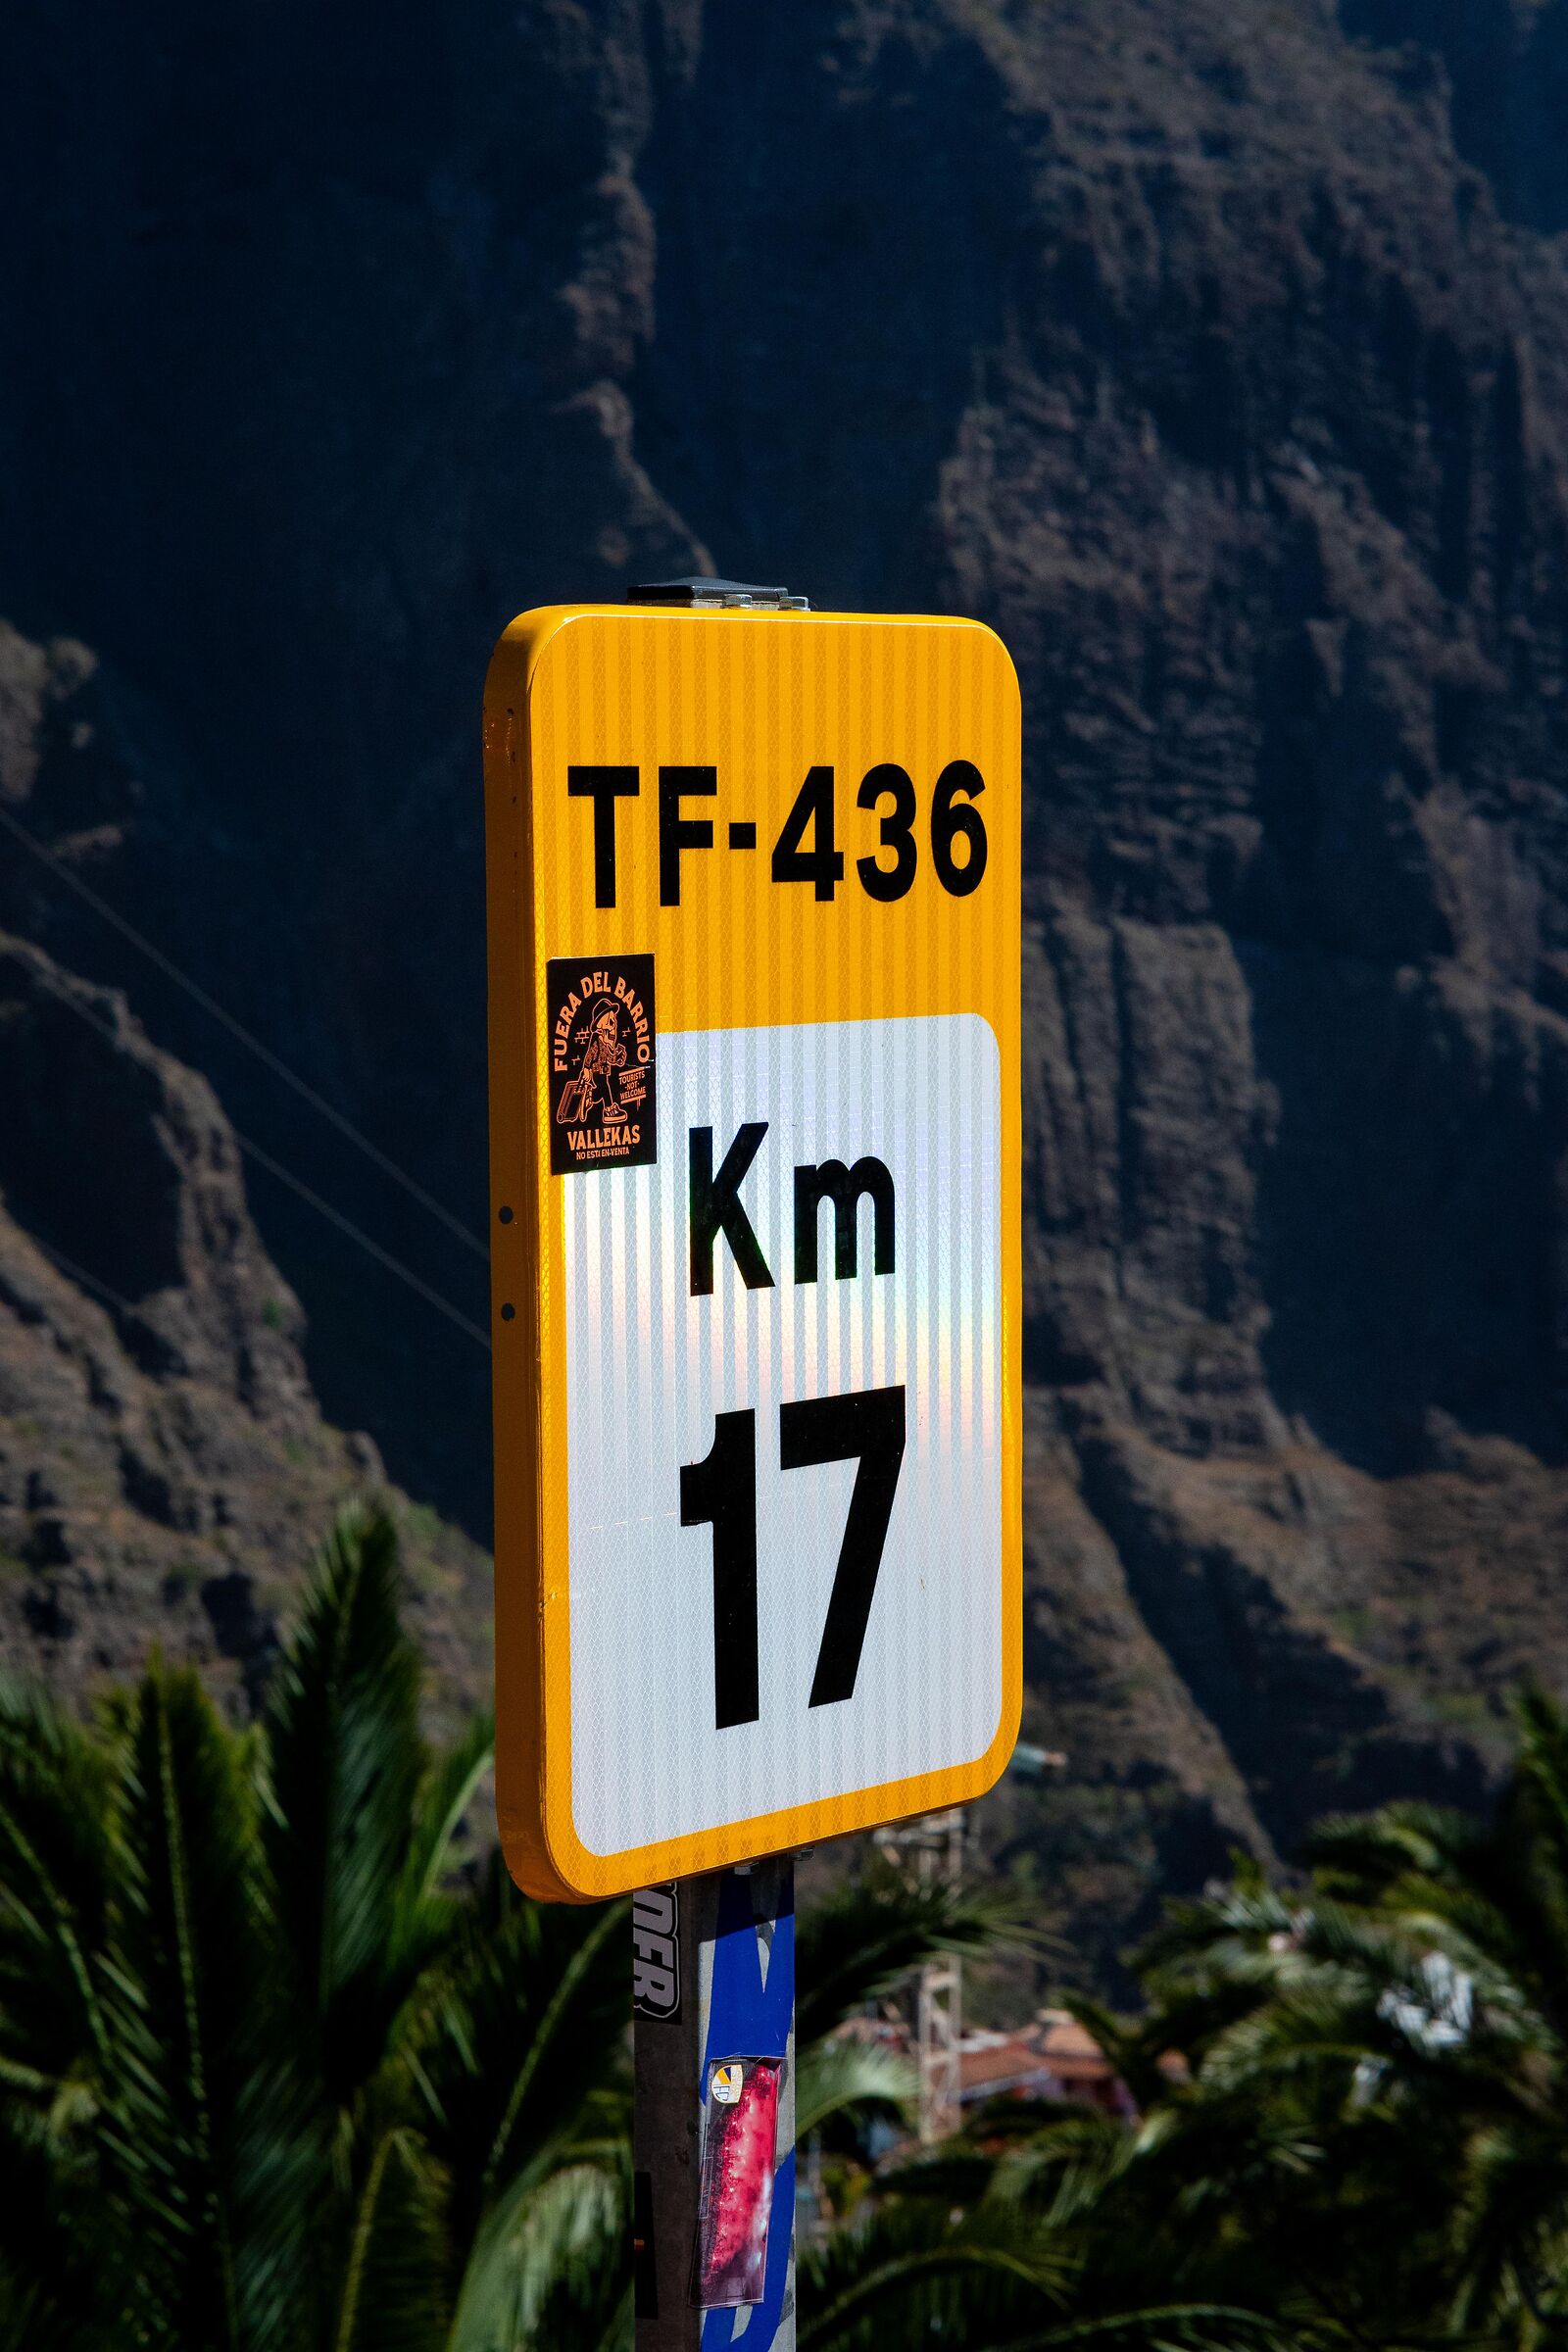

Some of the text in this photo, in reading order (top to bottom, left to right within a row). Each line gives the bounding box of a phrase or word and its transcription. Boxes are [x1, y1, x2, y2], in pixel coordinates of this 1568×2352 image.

[567, 760, 988, 908] TF-436
[554, 971, 651, 1072] FUERA DEL BARRIO
[618, 1070, 646, 1085] TOURISTS
[619, 1086, 647, 1101] WELCOME
[567, 1124, 641, 1152] VALLEKAS
[576, 1151, 586, 1160] NO
[689, 1121, 896, 1297] Km
[679, 1384, 906, 1731] 17
